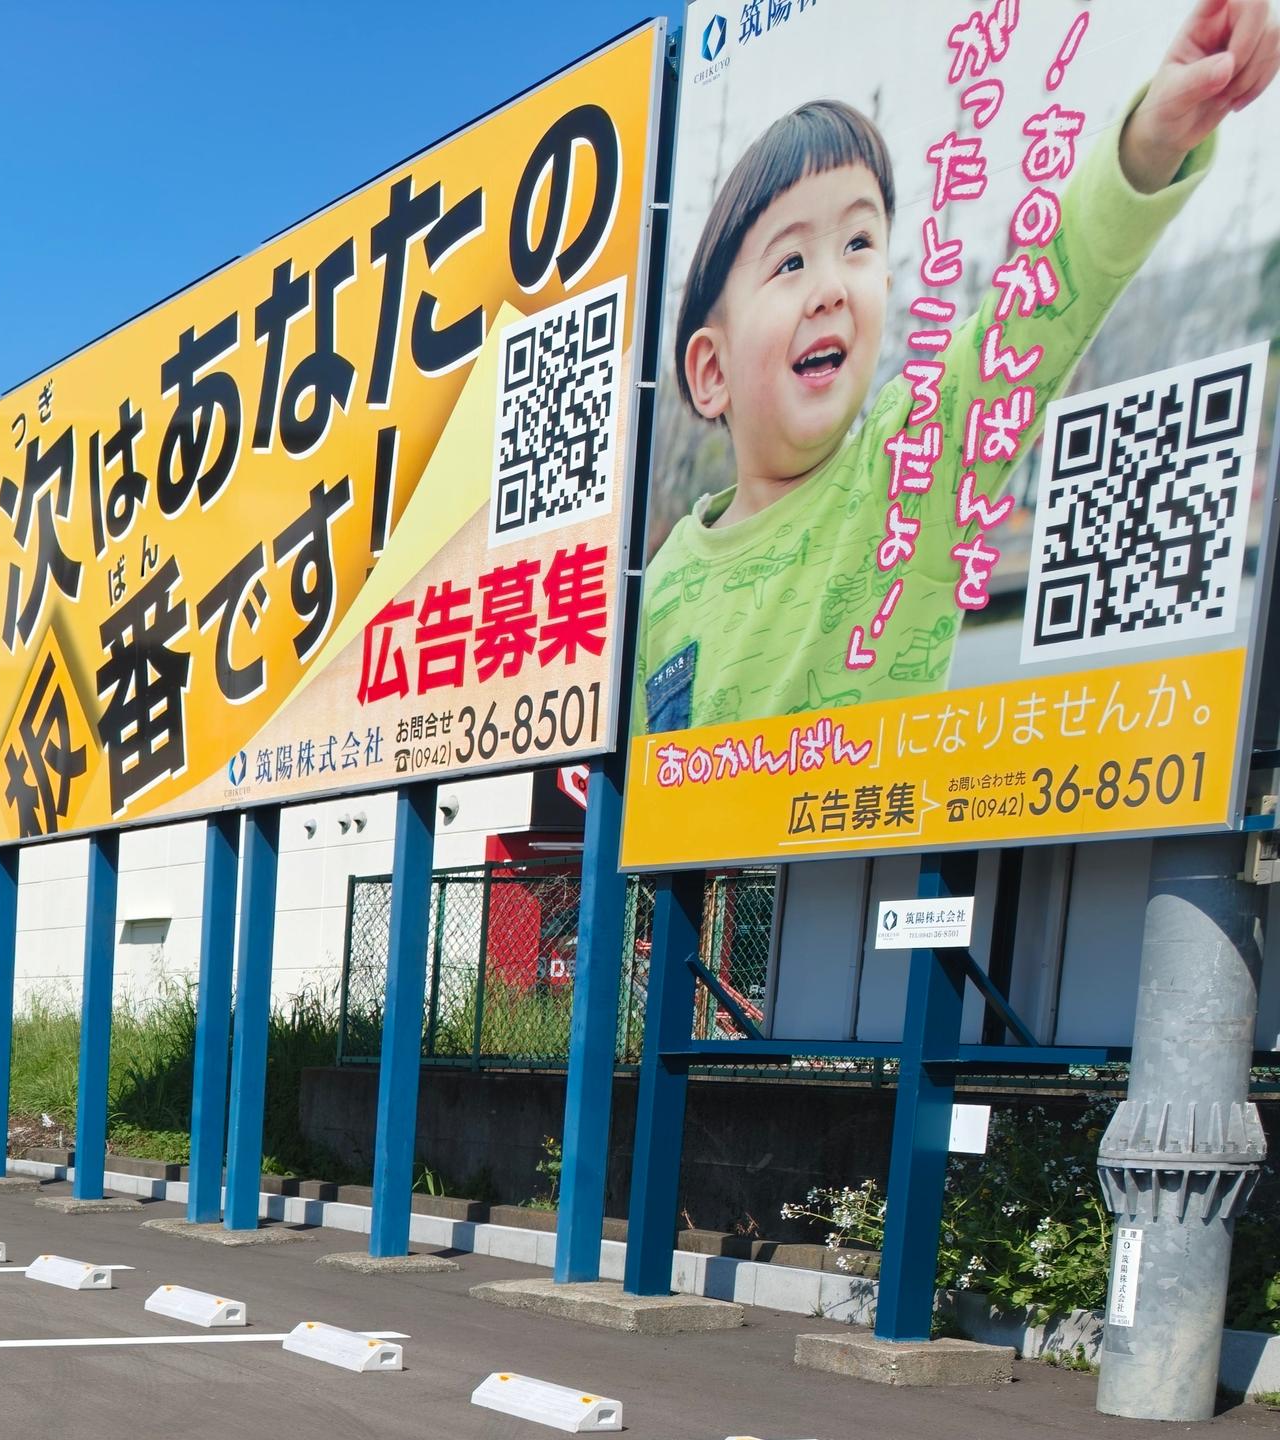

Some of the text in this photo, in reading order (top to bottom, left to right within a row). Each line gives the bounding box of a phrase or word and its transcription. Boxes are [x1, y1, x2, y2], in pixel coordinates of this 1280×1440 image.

[739, 0, 816, 46] 筑陽
[11, 378, 53, 450] つぎ
[108, 534, 159, 608] ばん
[357, 543, 608, 707] 広告募集
[254, 726, 384, 786] 筑陽株式会社
[395, 710, 454, 744] お問合せ
[410, 682, 602, 773] (0942) 36-8501
[787, 781, 917, 836] 広告募集
[948, 770, 1026, 793] お問い合わせ先
[971, 751, 1206, 821] (0942) 36-8501
